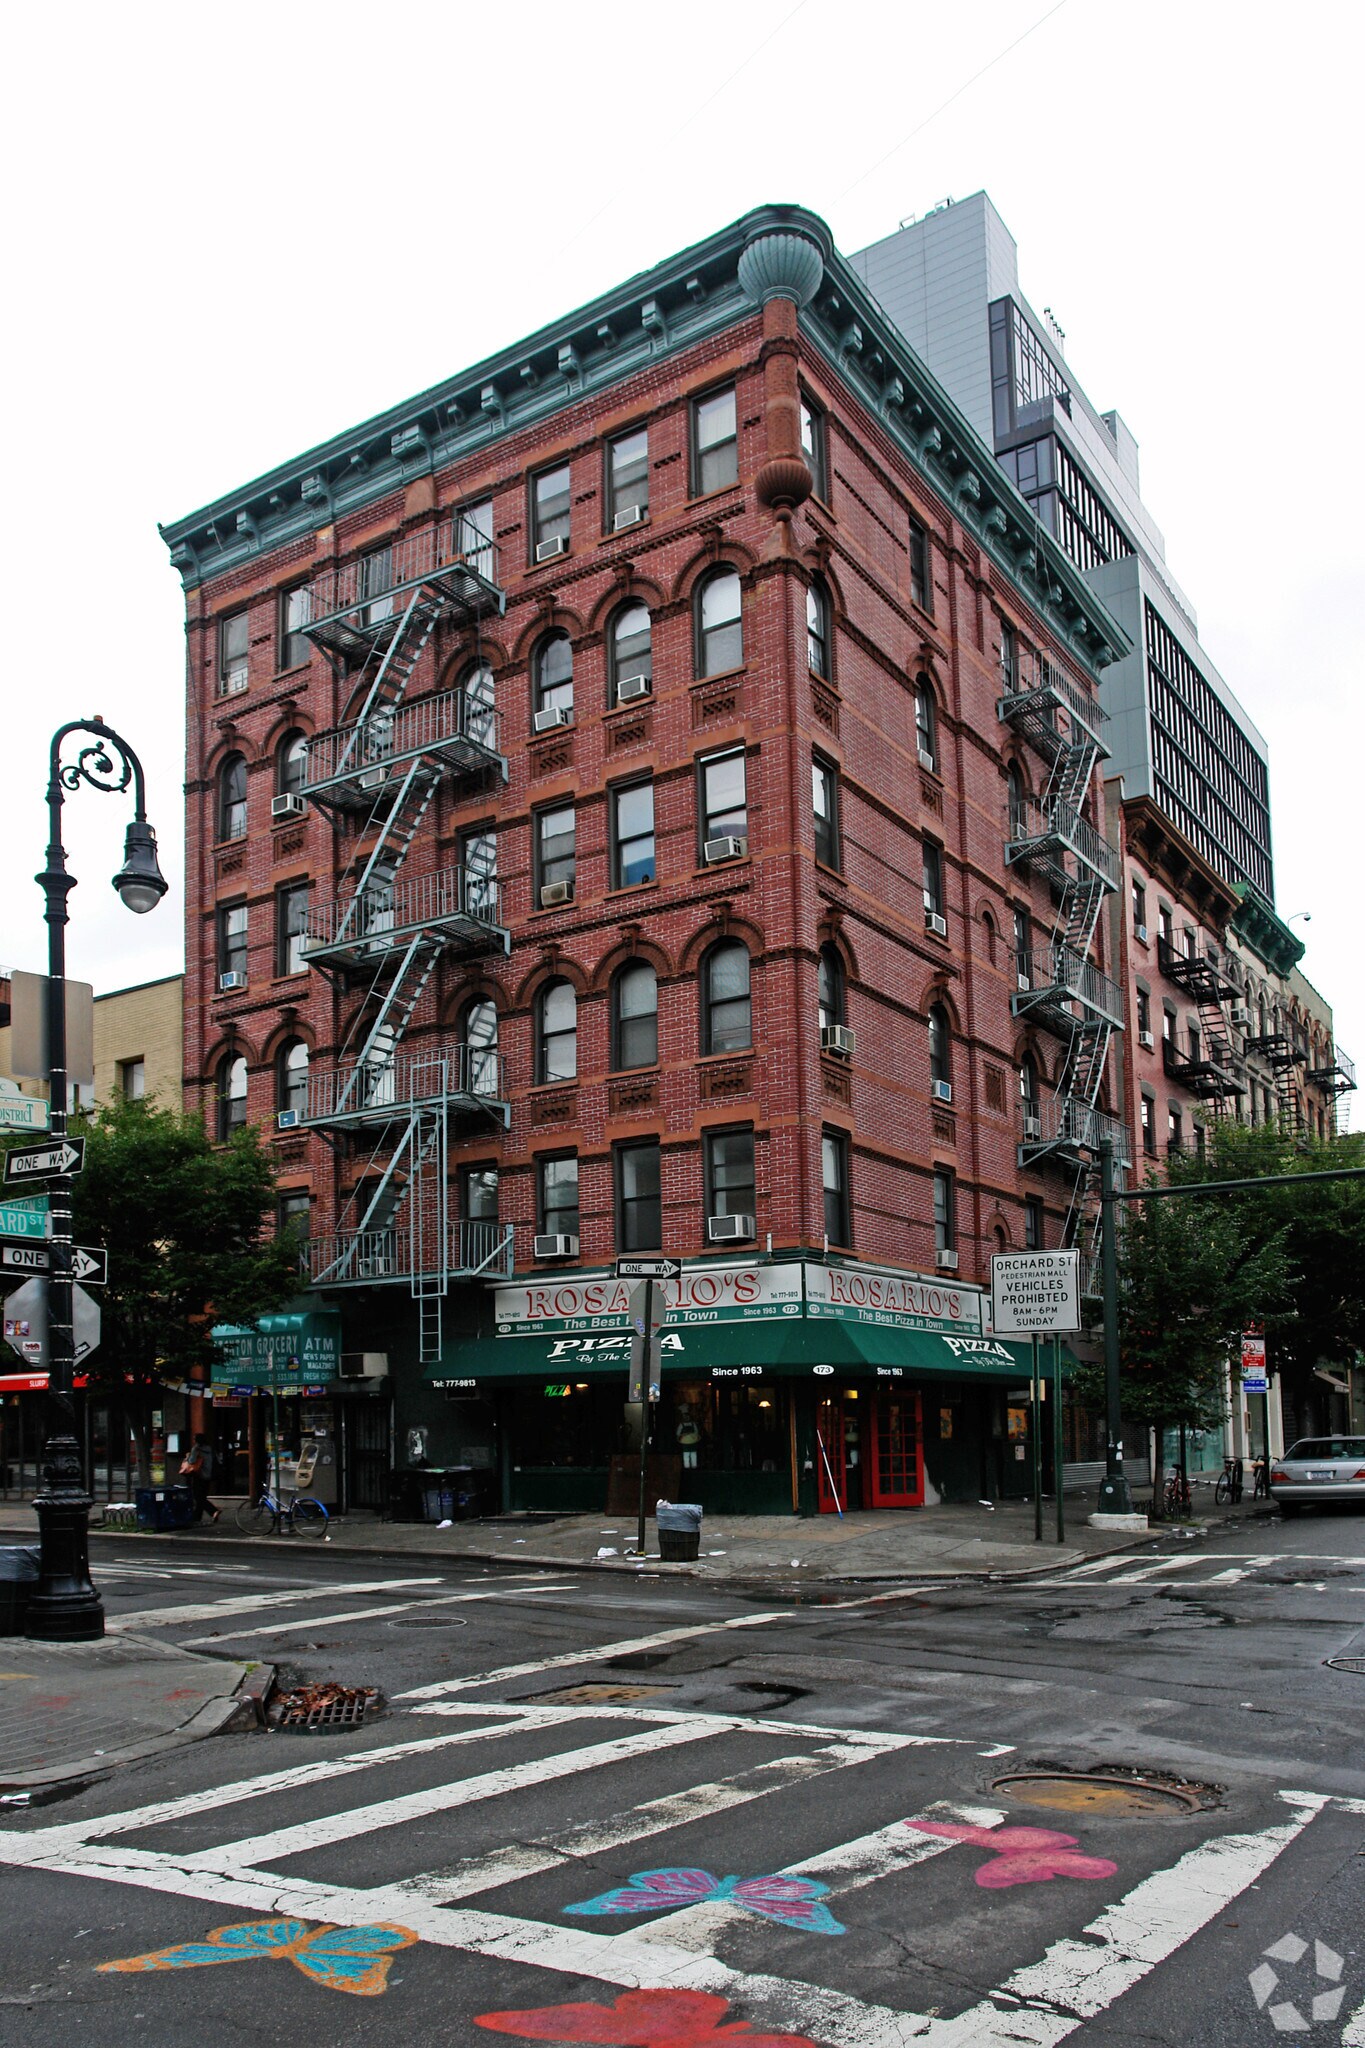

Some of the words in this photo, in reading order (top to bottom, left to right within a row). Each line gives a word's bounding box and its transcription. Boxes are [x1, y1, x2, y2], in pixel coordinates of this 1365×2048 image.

[16, 1156, 39, 1171] ONE
[49, 1150, 72, 1166] WAY
[29, 1215, 43, 1225] ST
[12, 1250, 45, 1266] ONE
[72, 1257, 90, 1271] AY
[996, 1257, 1054, 1271] ORCHARD
[1058, 1257, 1073, 1266] ST
[1001, 1271, 1046, 1280] PEDESTRIAN
[1006, 1280, 1064, 1292] VEHICLES
[829, 1270, 962, 1319] ROSARIO'S
[666, 1312, 678, 1322] in
[682, 1310, 718, 1321] Town
[743, 1307, 761, 1316] Since
[762, 1306, 776, 1315] 1963
[784, 1305, 797, 1313] 173
[563, 1319, 587, 1330] The
[591, 1317, 621, 1328] Best
[858, 1309, 873, 1321] The
[875, 1312, 893, 1324] Best
[895, 1315, 915, 1327] Pizza
[916, 1318, 923, 1327] in
[925, 1319, 943, 1330] Town
[1016, 1317, 1055, 1326] SUNDAY
[256, 1335, 298, 1355] GROCERY
[304, 1337, 334, 1351] ATM
[941, 1336, 1016, 1362] PIZZA
[576, 1354, 594, 1363] By
[597, 1353, 620, 1362] The
[712, 1367, 739, 1376] Since
[741, 1366, 763, 1375] 1963
[877, 1367, 891, 1376] Since
[892, 1368, 903, 1376] 1963
[445, 1379, 476, 1387] 777-9813
